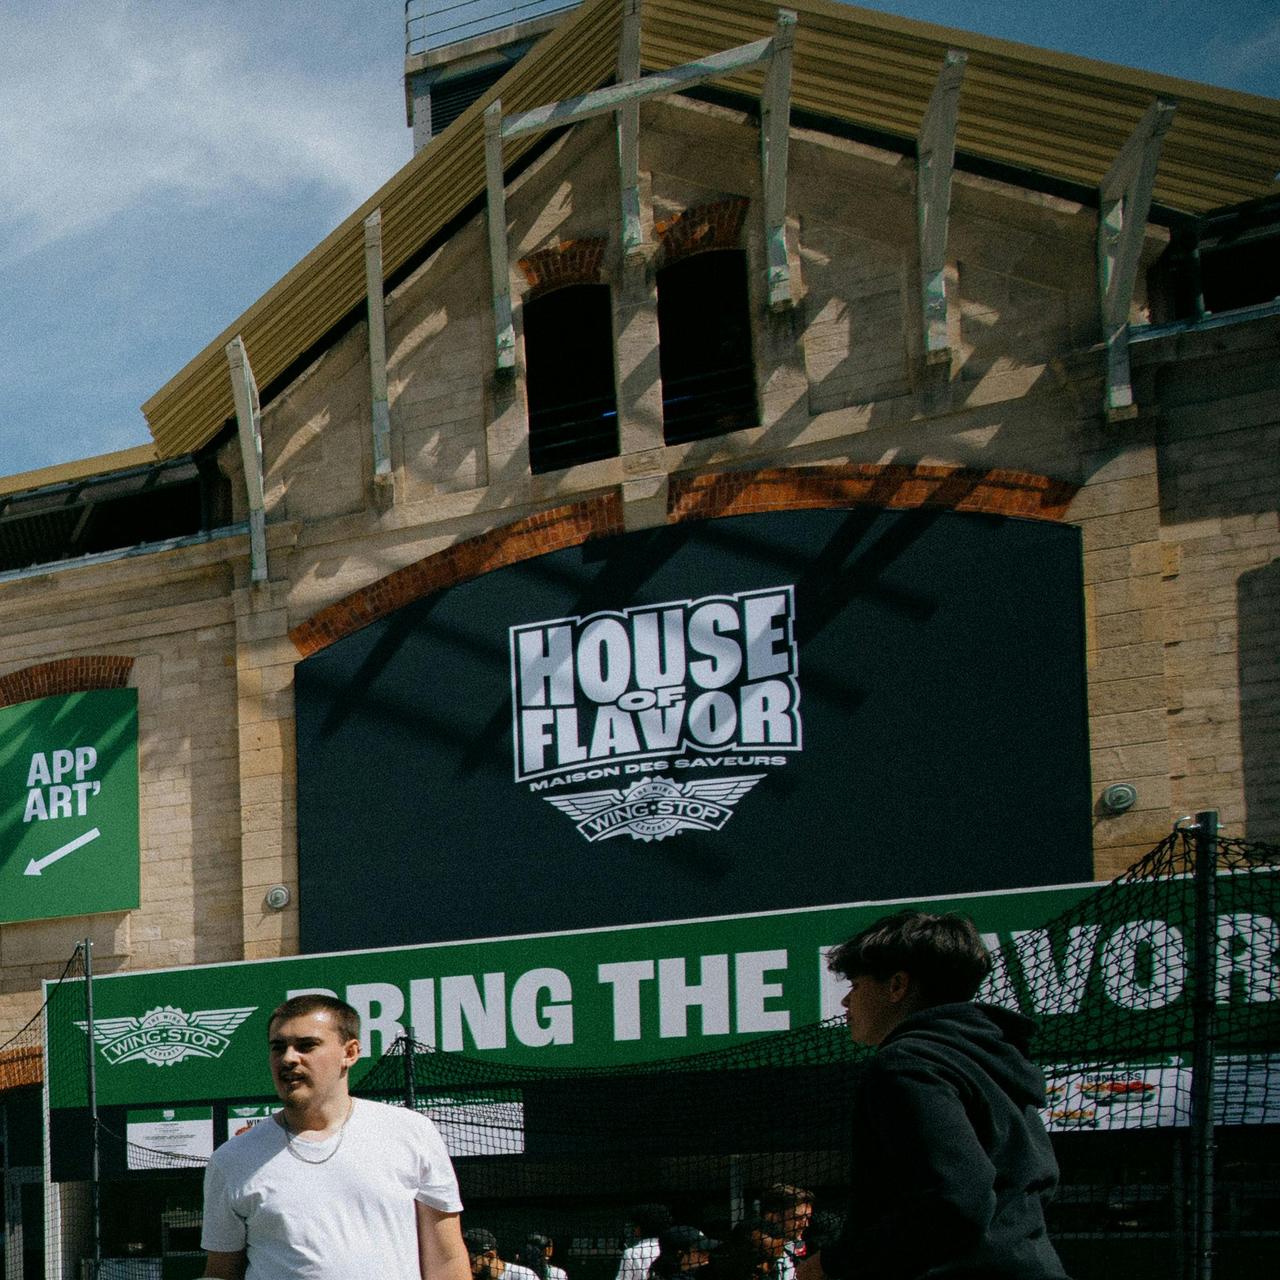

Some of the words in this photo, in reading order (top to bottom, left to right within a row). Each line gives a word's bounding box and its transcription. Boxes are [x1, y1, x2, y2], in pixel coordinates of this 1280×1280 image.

[518, 594, 789, 706] HOUSE
[521, 679, 793, 774] FLAVOR
[617, 686, 686, 712] OF
[26, 746, 98, 787] APP
[529, 766, 621, 793] MAISON
[625, 760, 669, 774] DES
[674, 755, 787, 770] SAVEURS
[286, 966, 574, 1060] RING
[596, 948, 791, 1042] THE
